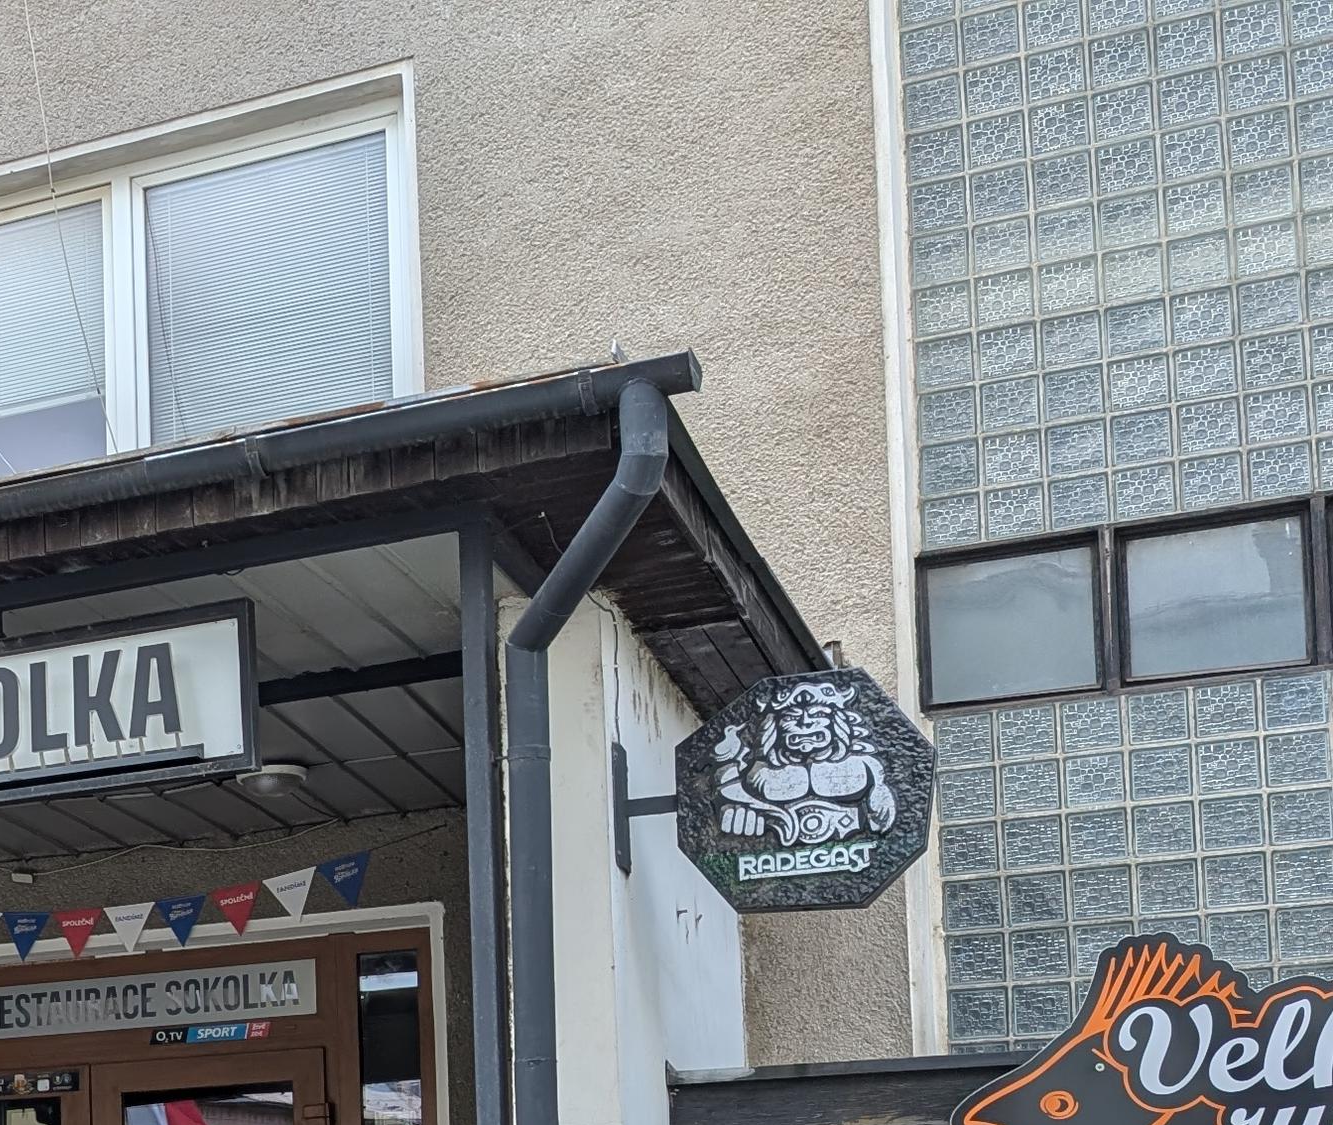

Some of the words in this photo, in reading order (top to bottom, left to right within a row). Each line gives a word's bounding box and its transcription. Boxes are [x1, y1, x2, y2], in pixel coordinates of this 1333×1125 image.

[739, 841, 877, 881] RADEGAST
[165, 970, 300, 1016] SOKOLKA
[197, 1027, 237, 1039] SPORT
